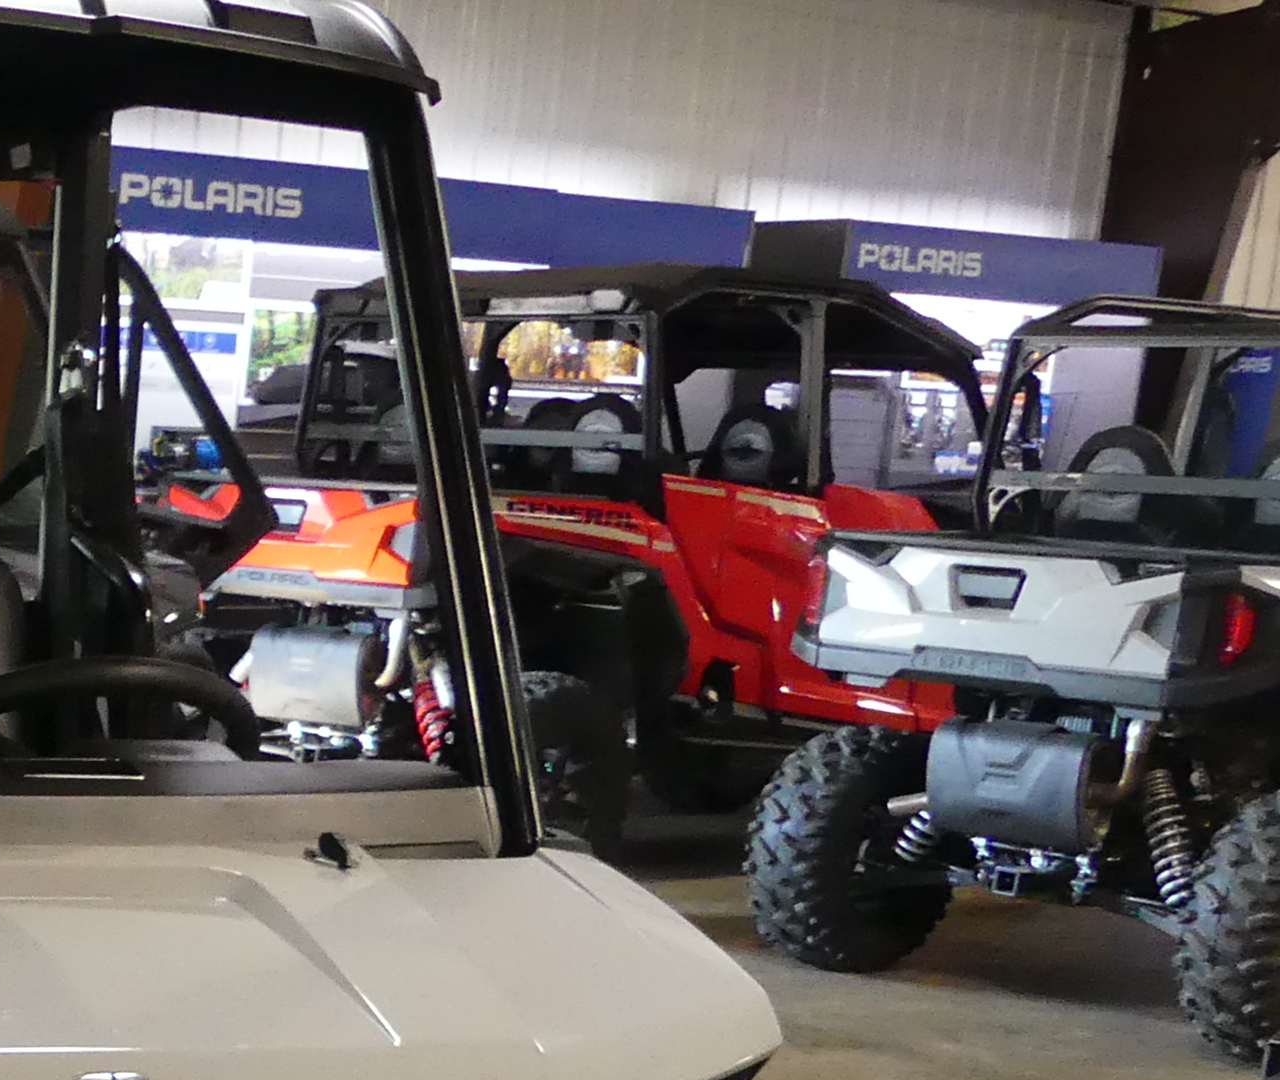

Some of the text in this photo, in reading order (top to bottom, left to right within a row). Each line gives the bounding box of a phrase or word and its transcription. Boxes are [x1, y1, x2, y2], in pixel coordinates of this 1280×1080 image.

[120, 173, 303, 219] POLARIS
[857, 242, 983, 278] POLARIS
[237, 570, 309, 585] POLARIS
